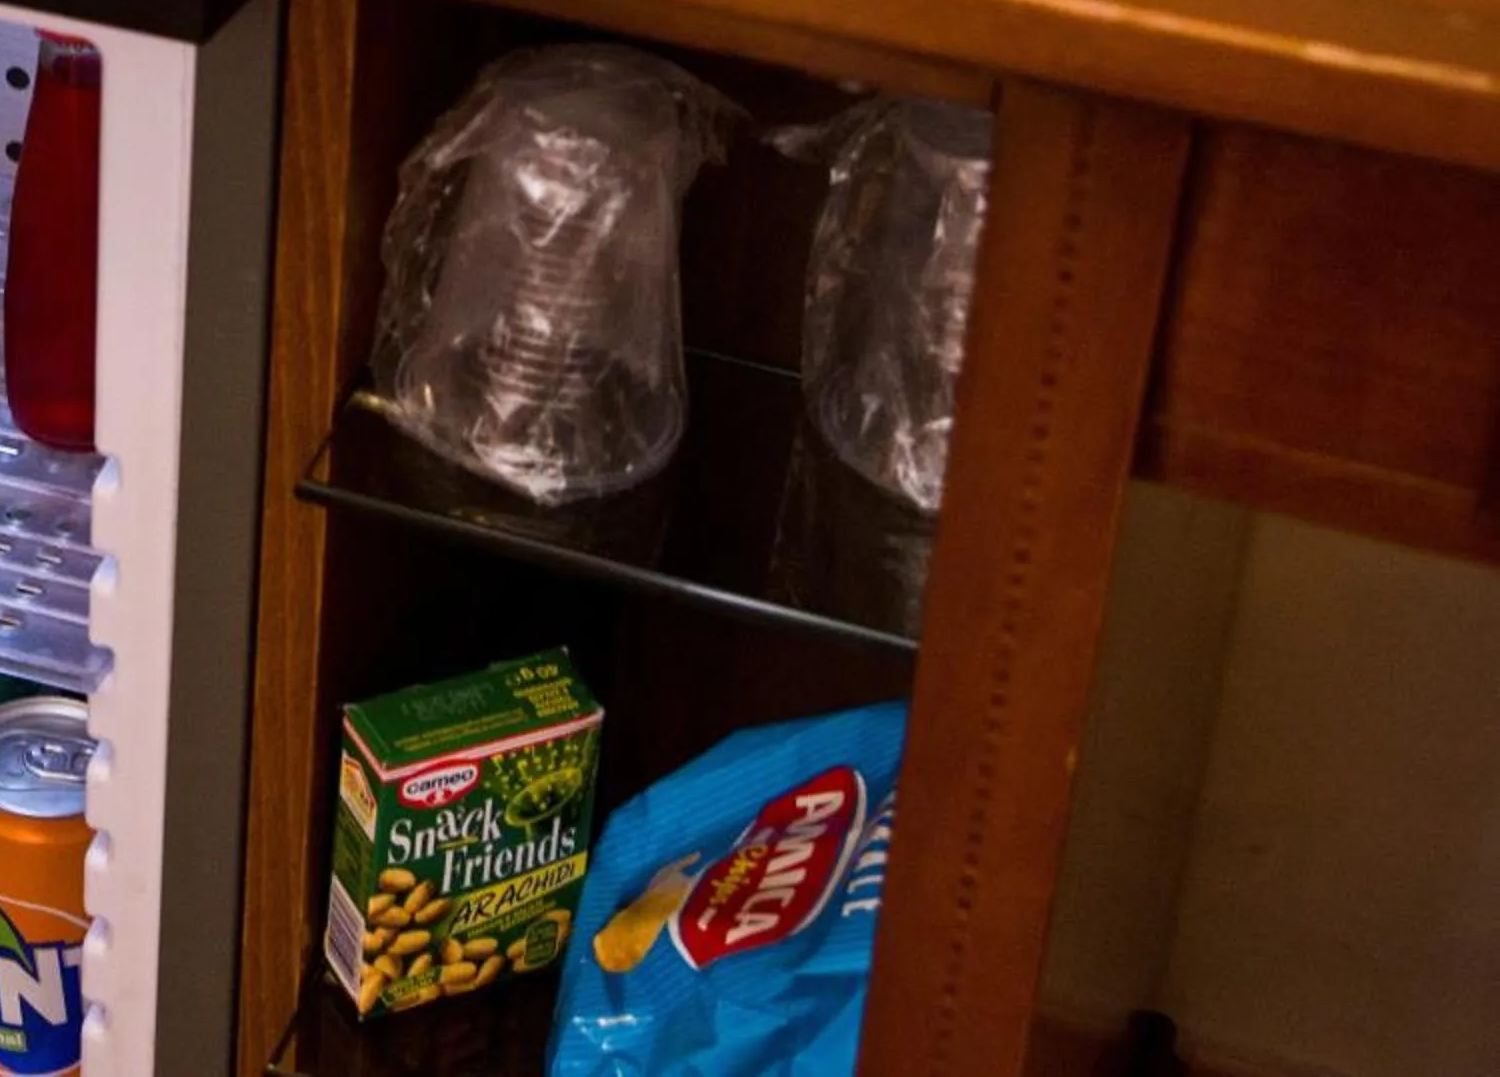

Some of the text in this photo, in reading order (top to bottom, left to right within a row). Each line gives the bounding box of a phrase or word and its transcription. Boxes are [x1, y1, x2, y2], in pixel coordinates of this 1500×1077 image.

[406, 768, 474, 795] cameo
[388, 798, 503, 865] Snack
[441, 817, 577, 895] Friends
[452, 861, 576, 929] ARACHIDI
[725, 790, 845, 945] AMICA
